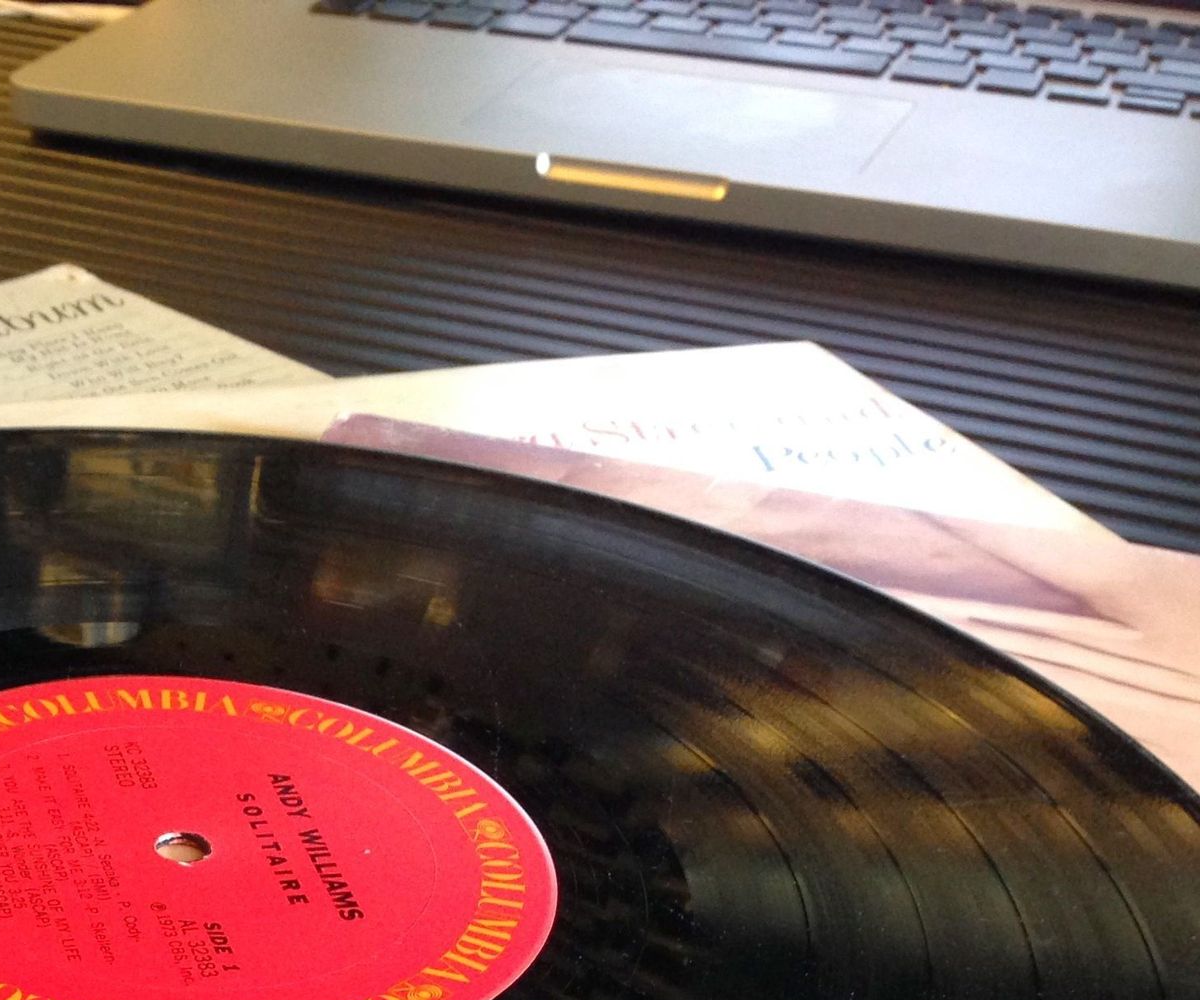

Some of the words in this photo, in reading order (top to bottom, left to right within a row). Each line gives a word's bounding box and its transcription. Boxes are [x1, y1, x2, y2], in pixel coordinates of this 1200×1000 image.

[104, 744, 137, 788] STEREO
[288, 707, 488, 820] COLUMBIA
[236, 793, 309, 905] SOLITAIRE
[267, 771, 312, 819] ANDY
[298, 828, 364, 921] WILLIAMS
[47, 899, 65, 914] OF
[61, 938, 82, 962] LIFE
[178, 918, 200, 935] AL
[422, 841, 527, 984] COLUMBIA
[187, 939, 220, 979] 32383
[203, 921, 234, 955] SIDE
[222, 963, 241, 973] 1
